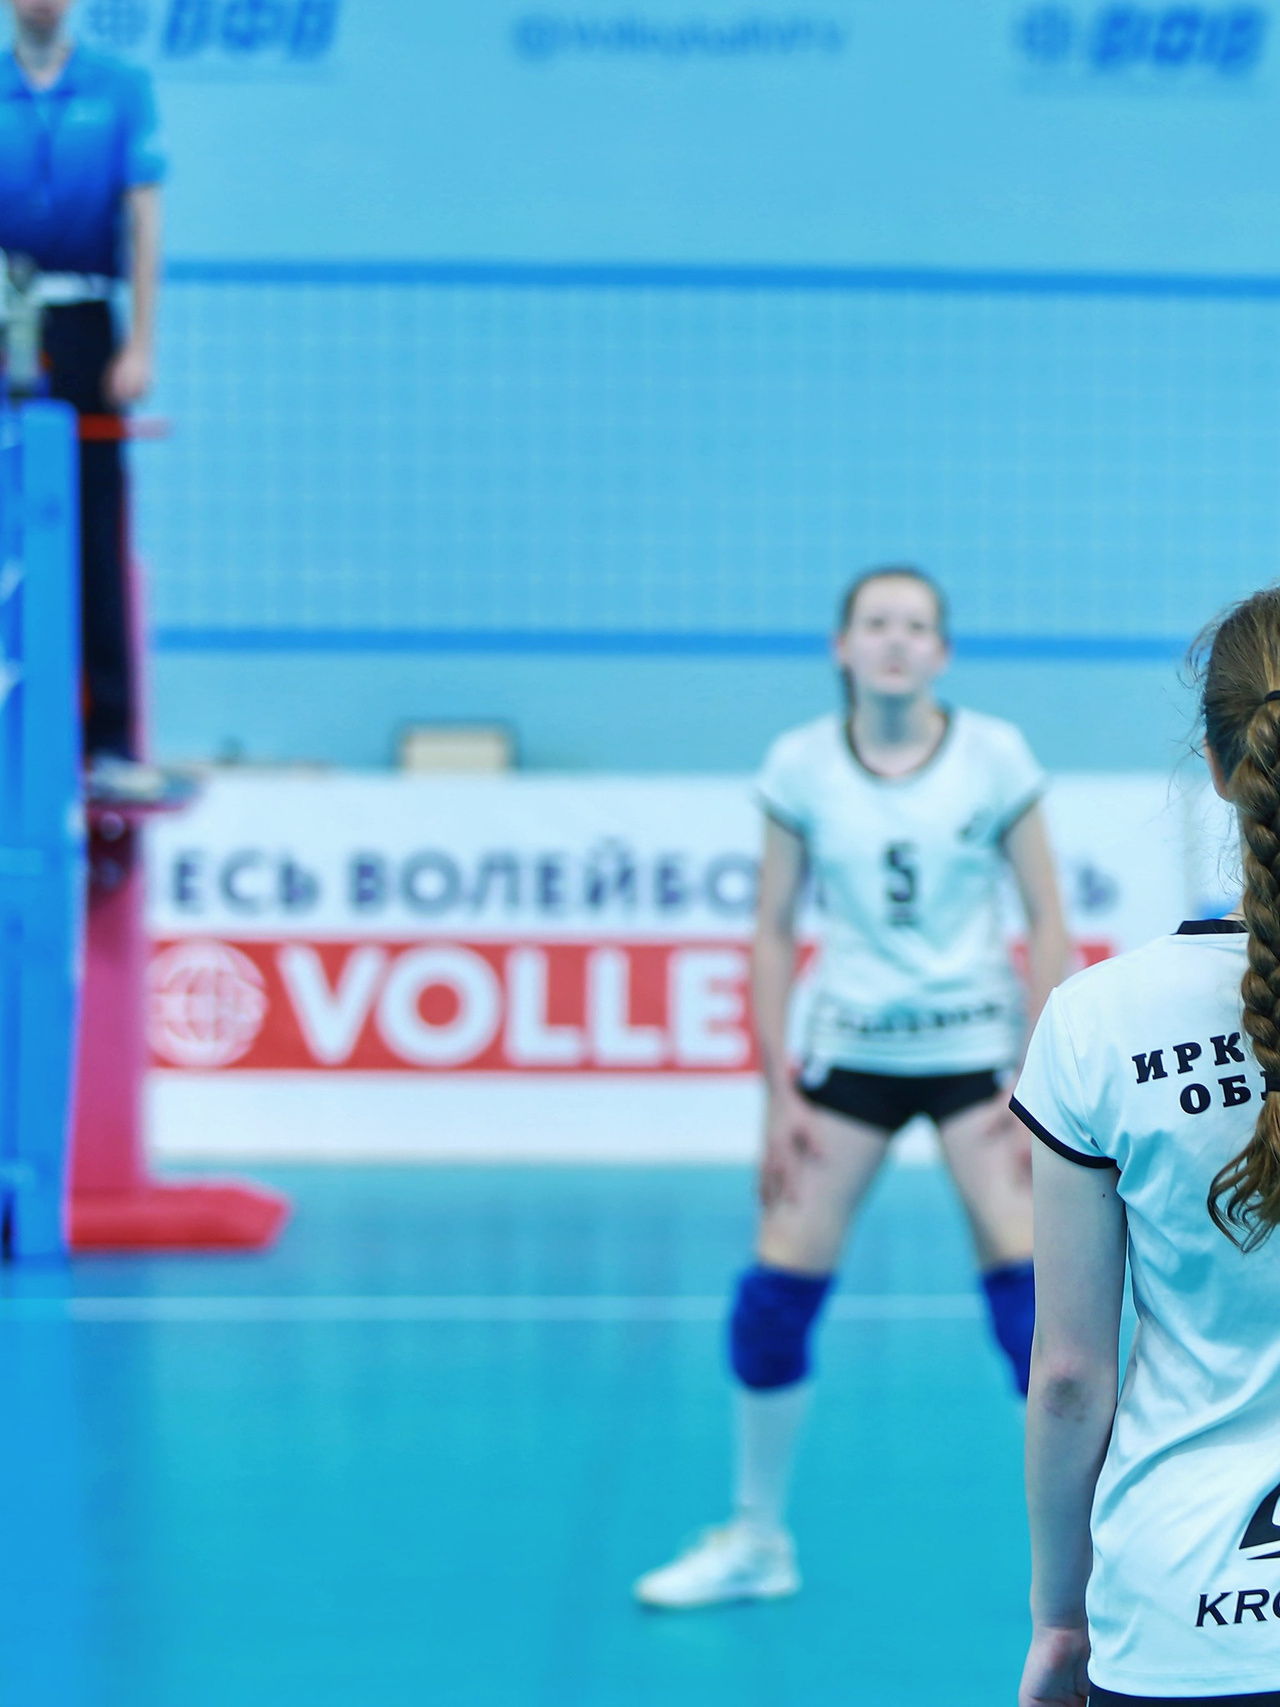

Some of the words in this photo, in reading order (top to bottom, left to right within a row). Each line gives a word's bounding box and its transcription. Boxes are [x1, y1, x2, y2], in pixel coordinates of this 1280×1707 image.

[171, 850, 321, 914] ЕСЬ
[347, 838, 765, 917] ВОЛЕЙБО
[884, 838, 917, 905] 5
[276, 943, 755, 1068] VOLLE
